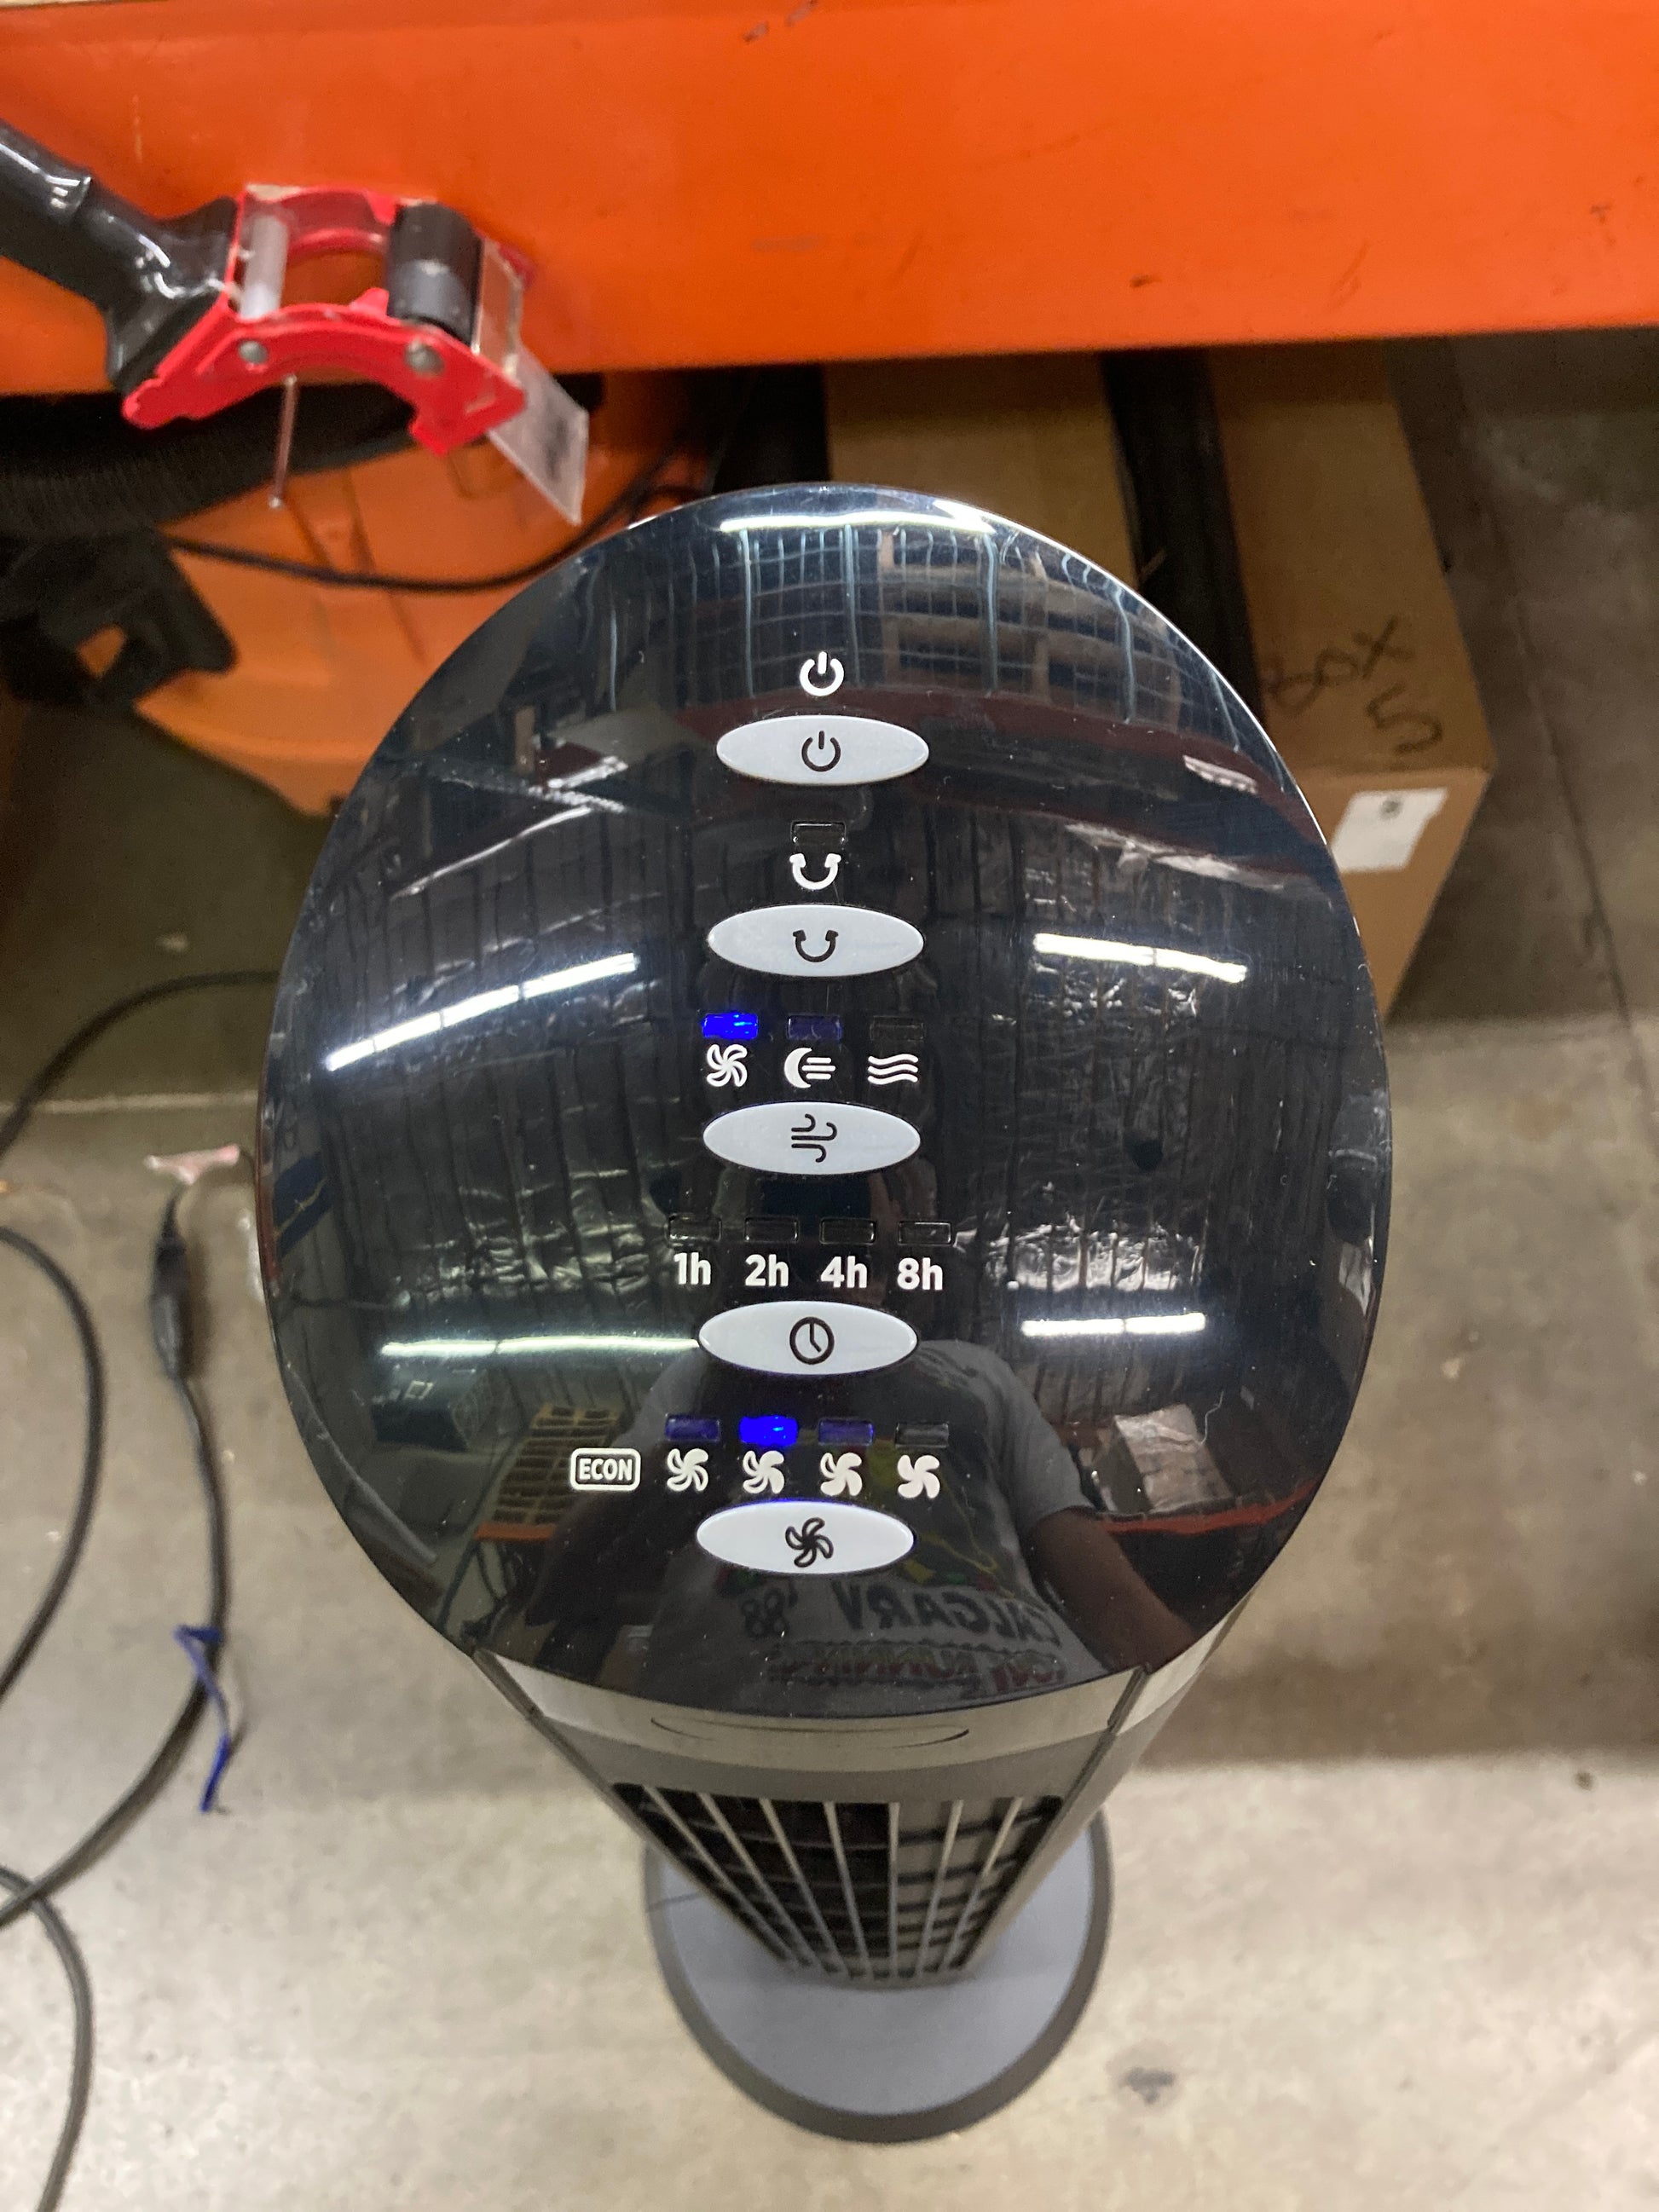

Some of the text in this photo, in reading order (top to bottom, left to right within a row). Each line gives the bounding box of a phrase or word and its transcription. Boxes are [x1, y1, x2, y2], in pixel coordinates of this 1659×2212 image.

[673, 1251, 944, 1291] 1h 2h 4h 8h
[577, 1457, 633, 1481] ECON
